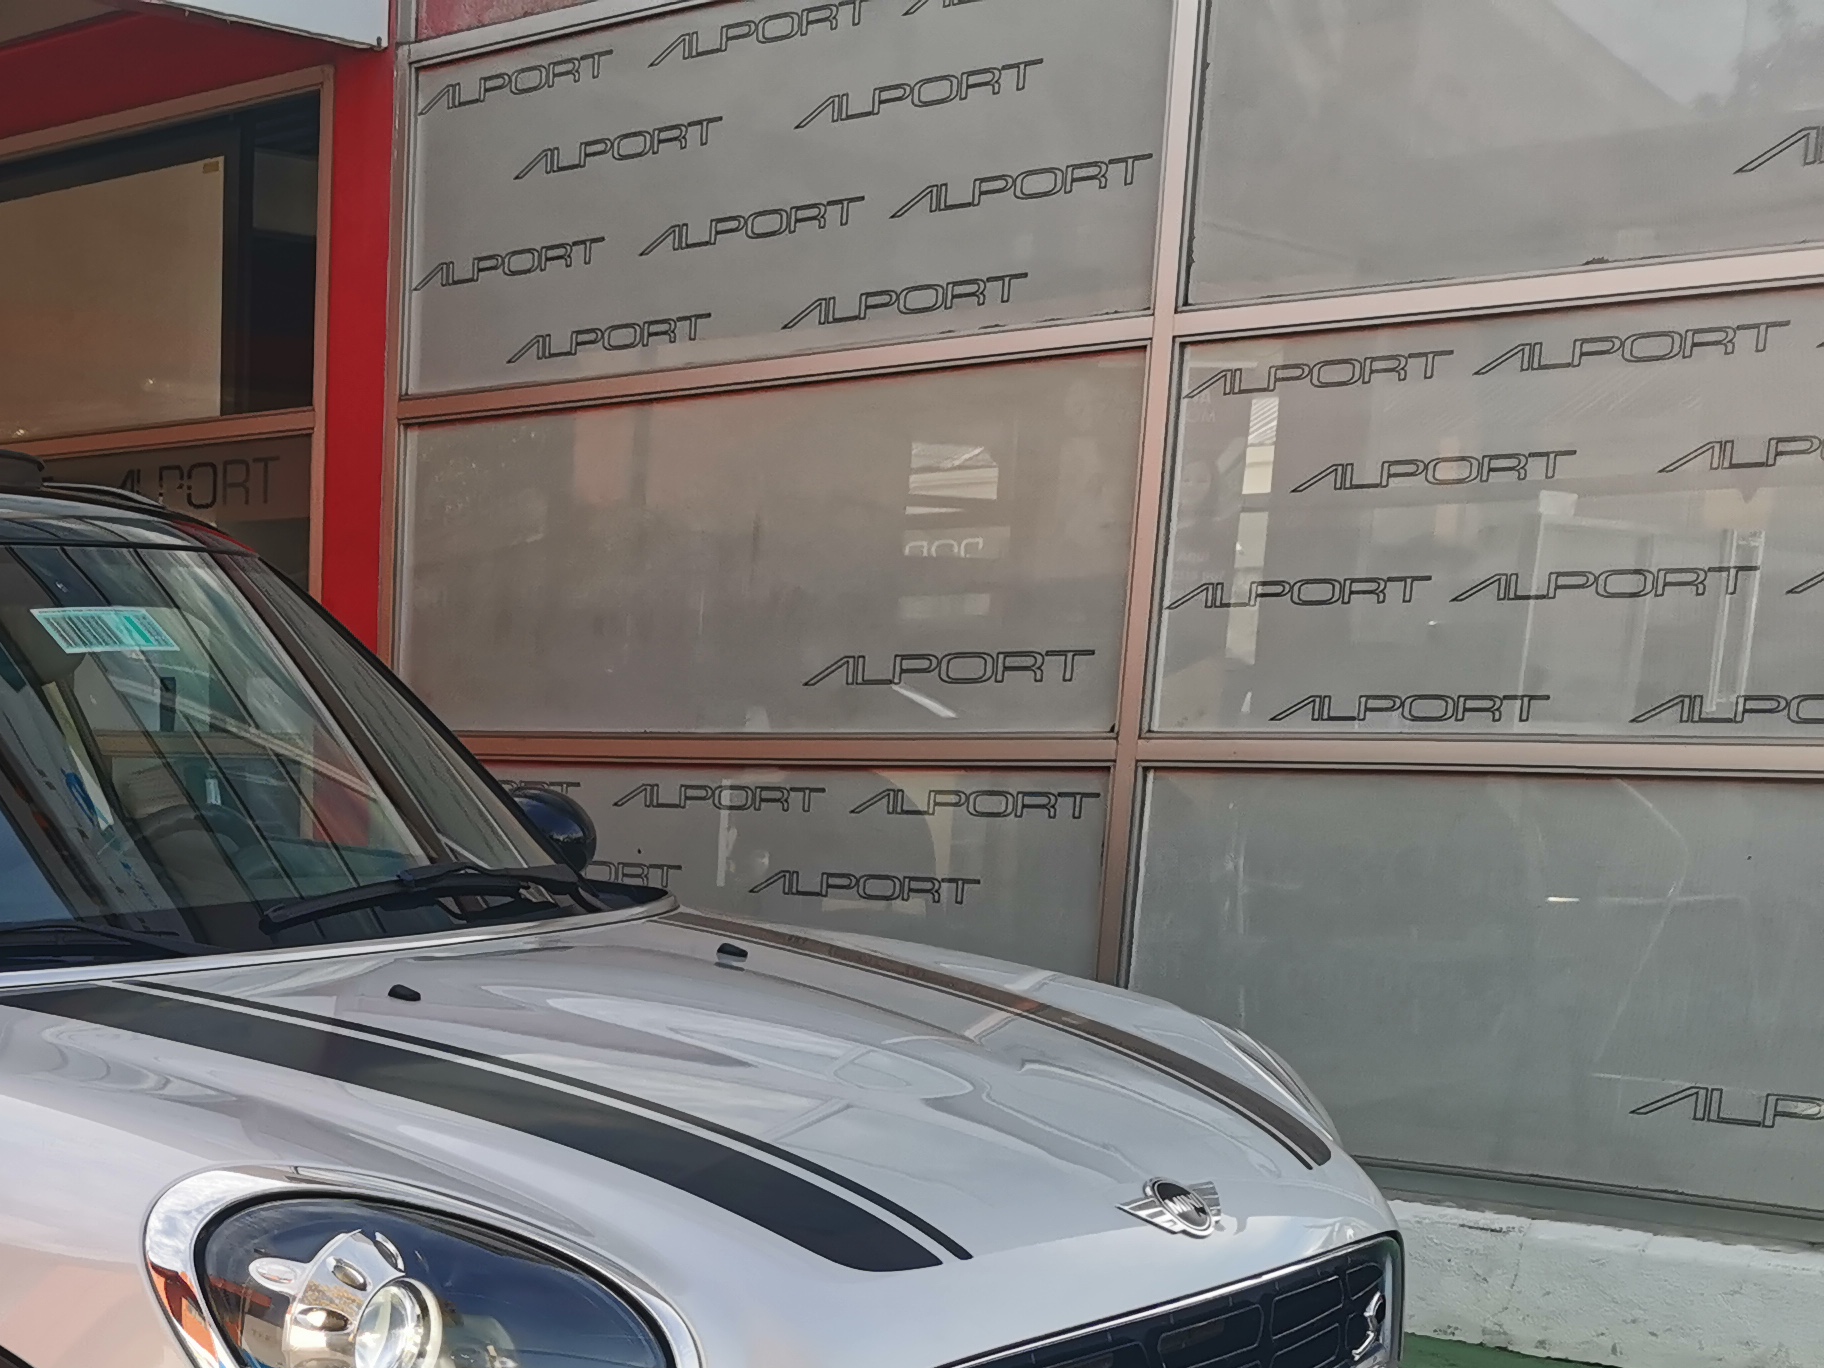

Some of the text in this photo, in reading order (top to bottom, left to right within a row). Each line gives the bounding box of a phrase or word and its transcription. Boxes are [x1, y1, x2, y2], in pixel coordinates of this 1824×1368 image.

[648, 0, 866, 67] ALPORT
[418, 50, 613, 116] ALPORT
[793, 58, 1044, 129] ALPORT
[514, 117, 723, 180] ALPORT
[890, 153, 1153, 219] ALPORT
[638, 196, 865, 257] ALPORT
[413, 237, 606, 291] ALPORT
[780, 272, 1029, 331] ALPORT
[507, 313, 711, 364] ALPORT
[1473, 320, 1791, 376] ALPORT
[1183, 350, 1454, 400] ALPORT
[1290, 450, 1577, 493] ALPORT
[1657, 435, 1824, 473] ALP
[1166, 575, 1432, 610] ALPORT
[1449, 565, 1760, 603] ALPORT
[802, 649, 1095, 686] ALPORT
[1269, 694, 1551, 724] ALPORT
[613, 783, 825, 812] ALPORT
[850, 788, 1100, 819] ALPORT
[749, 870, 981, 904] ALPORT
